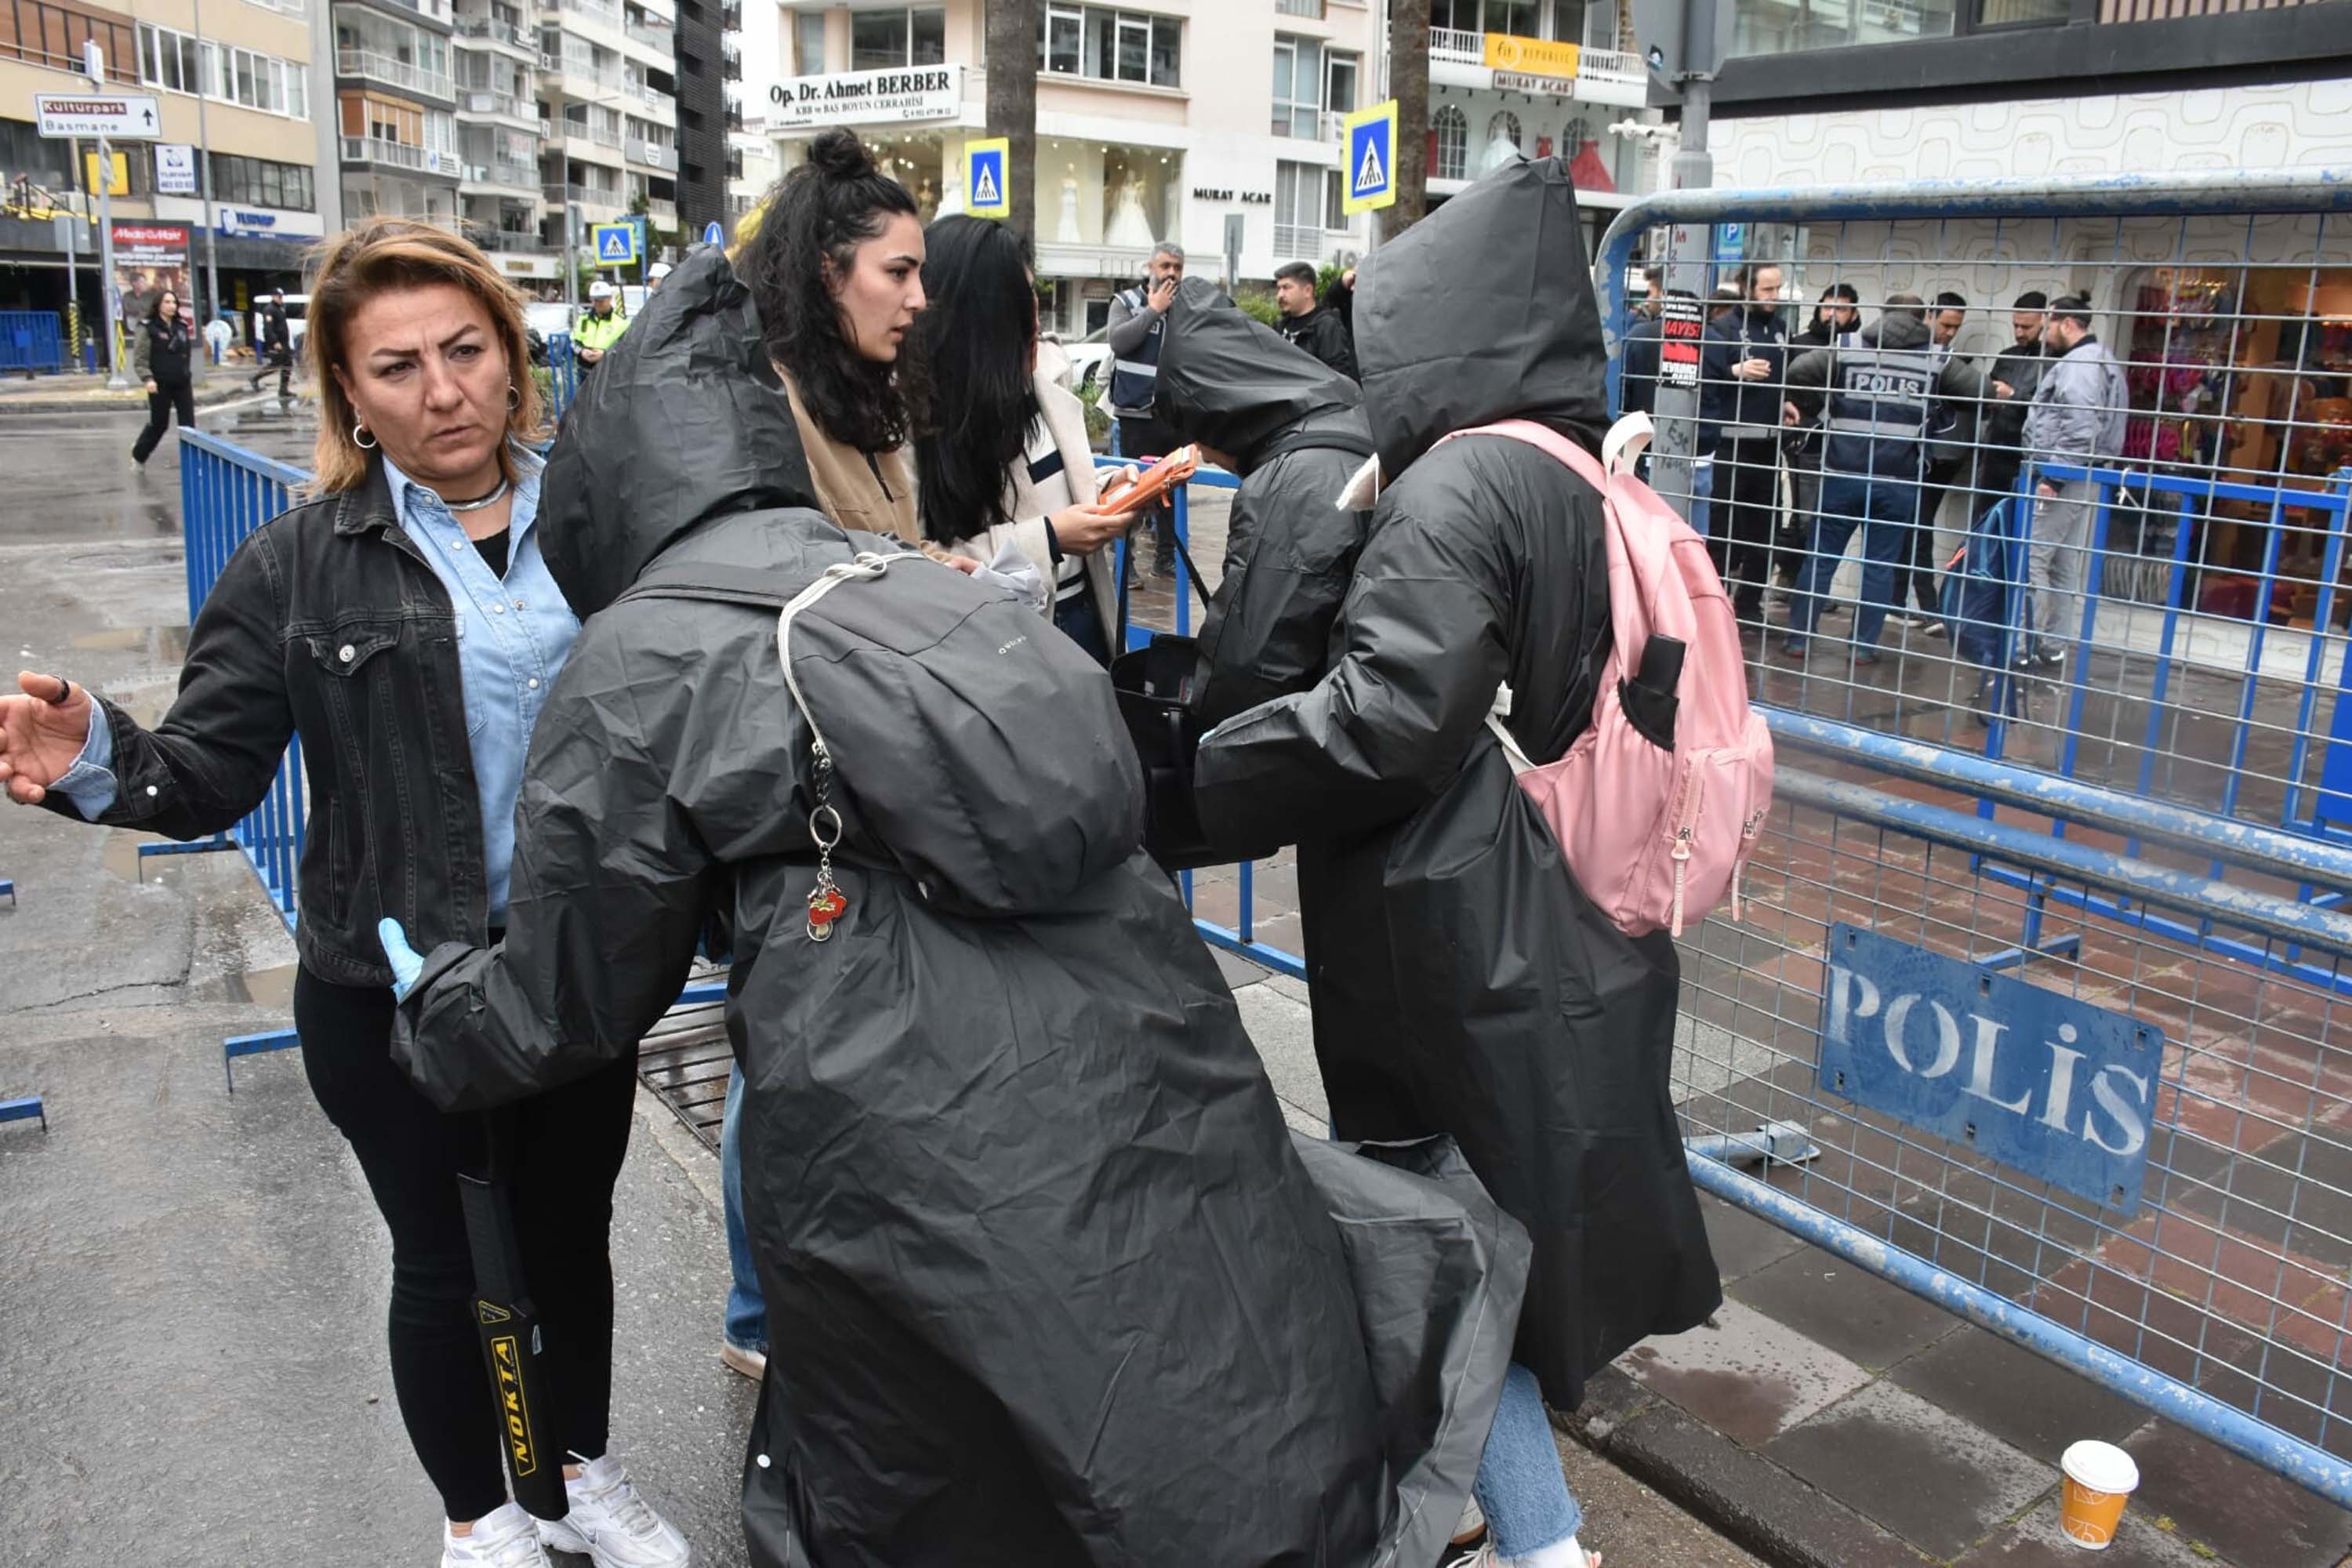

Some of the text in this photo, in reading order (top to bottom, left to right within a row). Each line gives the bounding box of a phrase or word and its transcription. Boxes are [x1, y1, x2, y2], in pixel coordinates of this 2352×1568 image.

[770, 71, 950, 107] Op. Dr. Ahmet BERBER
[1497, 74, 1537, 89] MURAT
[842, 100, 872, 112] BOYUN
[873, 94, 924, 109] CERRAHİSİ
[45, 119, 119, 132] Basmane
[1193, 187, 1272, 204] MURAT ACAR
[1824, 964, 2150, 1157] POLİS
[495, 1341, 530, 1464] NOKTA
